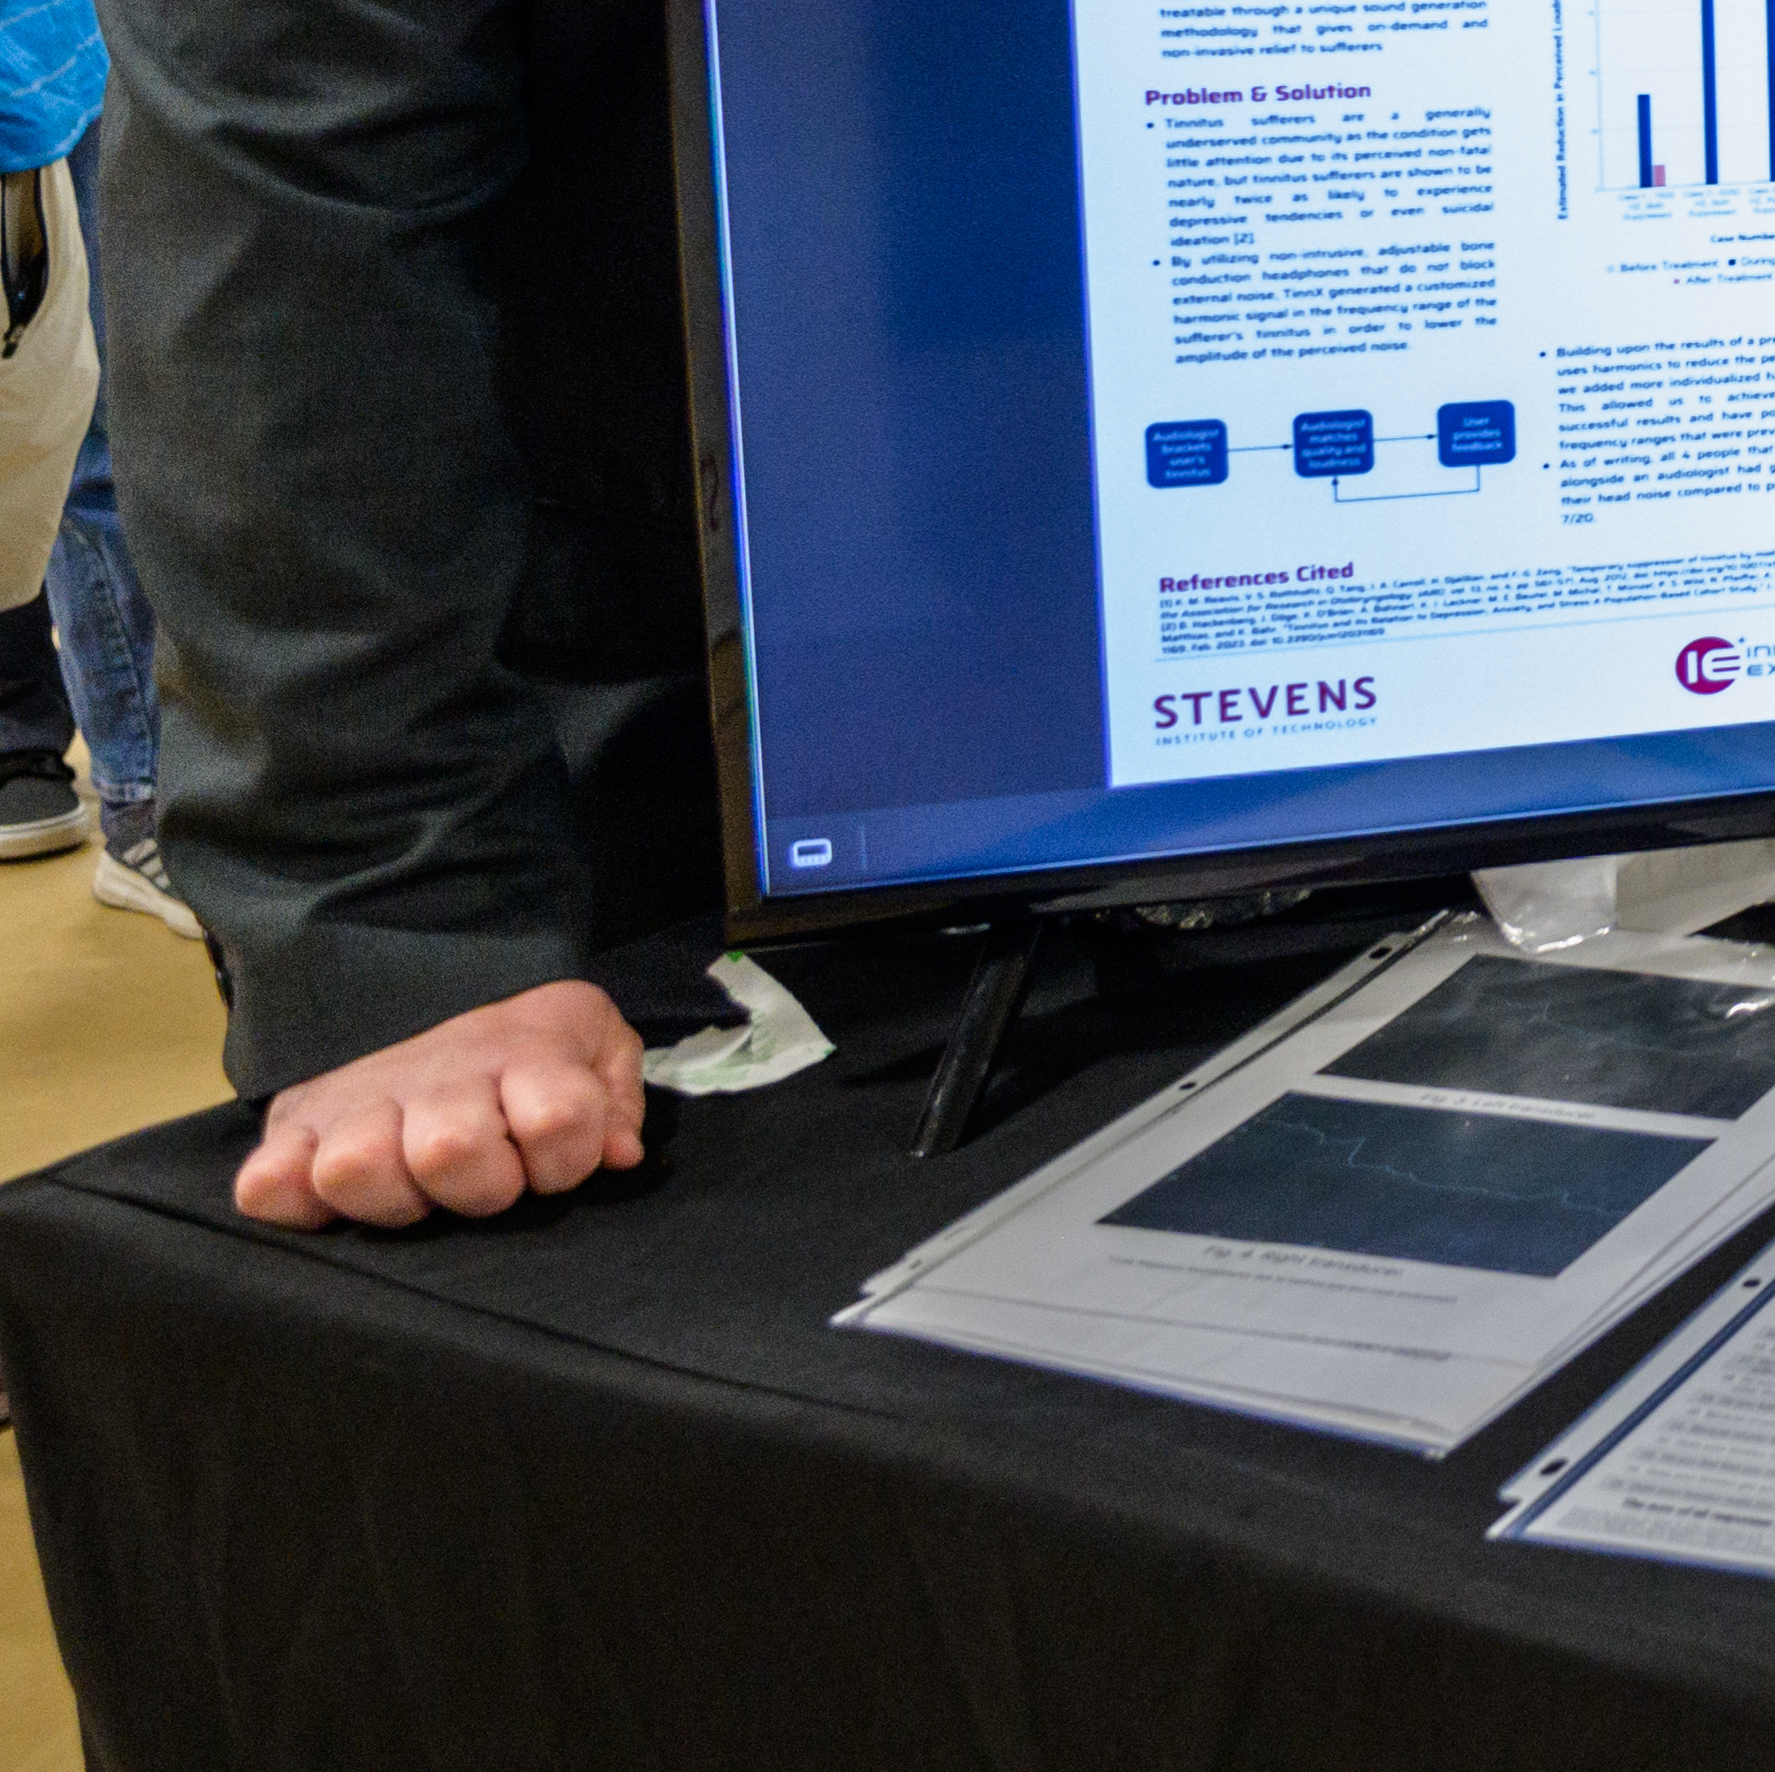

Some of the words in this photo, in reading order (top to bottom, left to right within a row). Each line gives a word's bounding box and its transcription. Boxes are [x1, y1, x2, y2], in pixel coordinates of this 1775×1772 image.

[1145, 87, 1244, 109] Problem
[1250, 85, 1269, 105] &
[1275, 82, 1372, 104] Solution
[1158, 568, 1290, 595] References
[1296, 561, 1355, 582] Cited
[1152, 675, 1378, 731] STEVENS
[1155, 730, 1237, 747] INSTITUTE
[1243, 727, 1265, 739] OF
[1271, 716, 1379, 736] TECHNOLOGY
